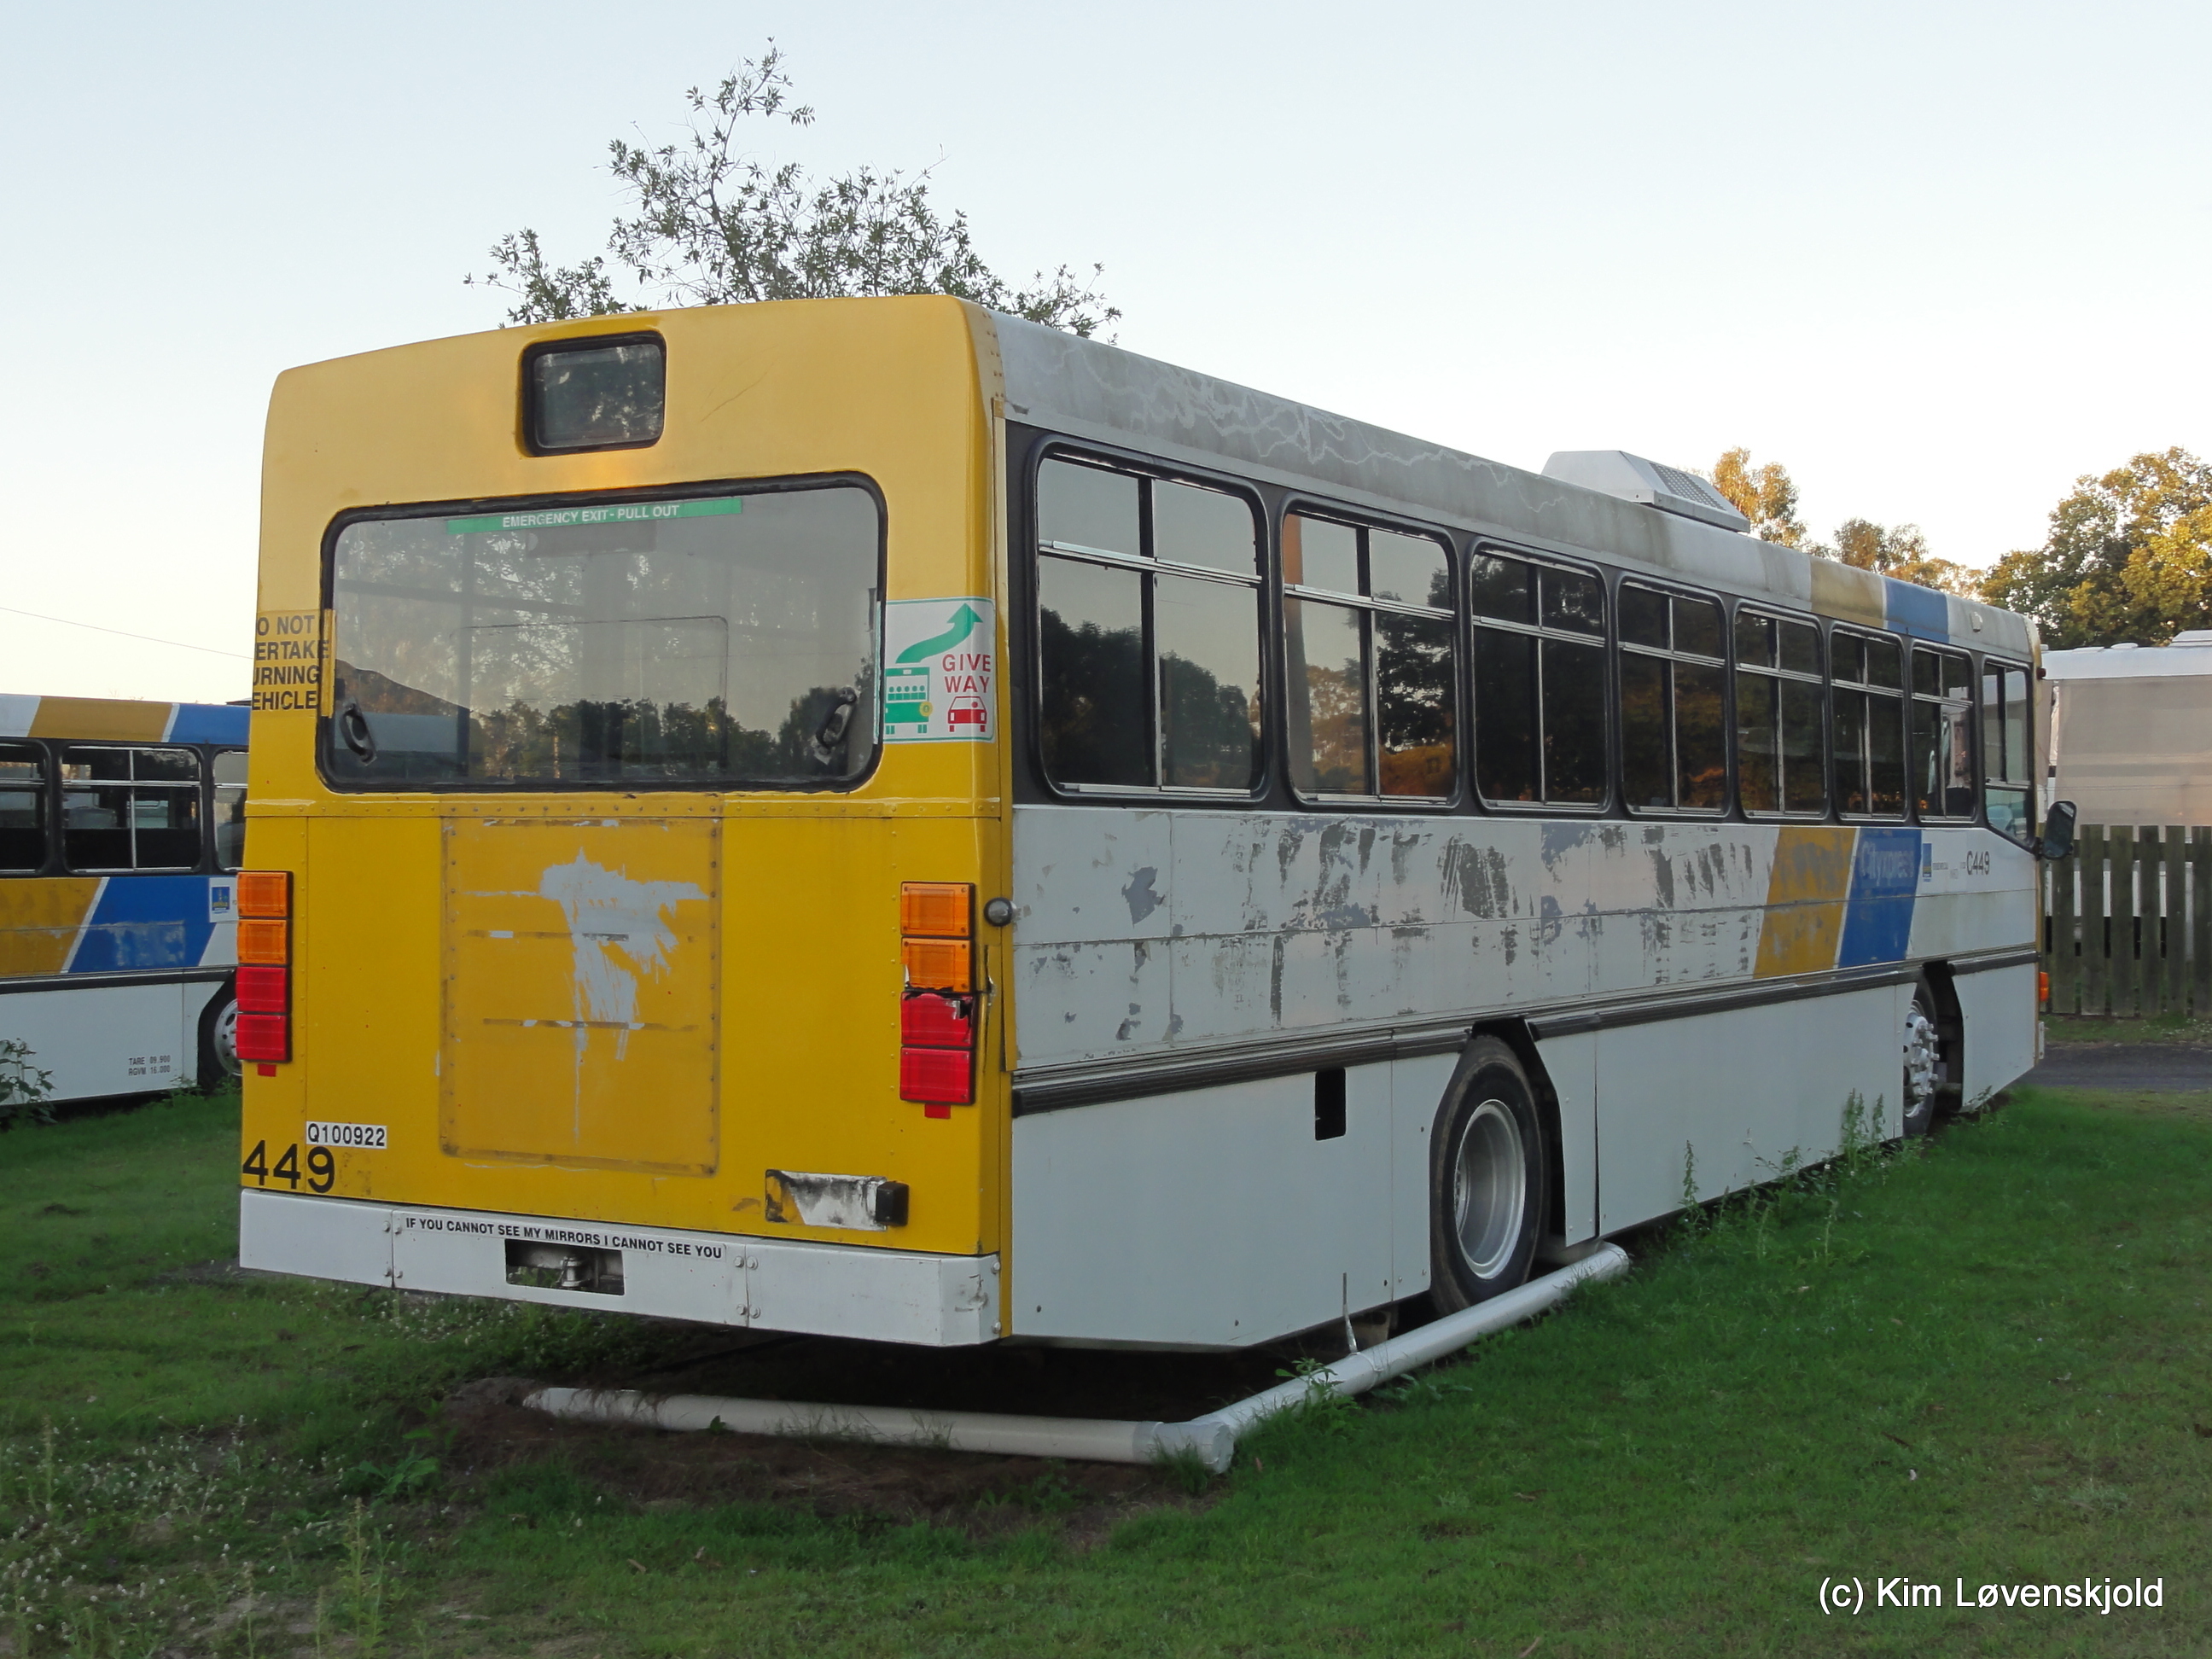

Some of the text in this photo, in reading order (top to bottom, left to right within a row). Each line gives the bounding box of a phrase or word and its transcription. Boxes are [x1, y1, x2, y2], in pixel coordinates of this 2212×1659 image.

[502, 511, 579, 528] EMERGENCY
[581, 509, 608, 522] EXIT
[617, 507, 649, 520] PULL
[653, 505, 680, 517] OUT
[257, 614, 316, 637] O NOT
[256, 640, 330, 661] ERTAKE
[942, 653, 992, 672] GIVE
[944, 675, 990, 693] WAY
[252, 690, 318, 710] EHICLE
[1966, 850, 1990, 876] C449
[128, 1057, 145, 1065] TARE
[307, 1123, 385, 1147] Q100922
[242, 1139, 335, 1194] 449
[406, 1218, 722, 1259] IF YOU CANNOT SEE MY MIRRORS I CANNOT SEE YOU
